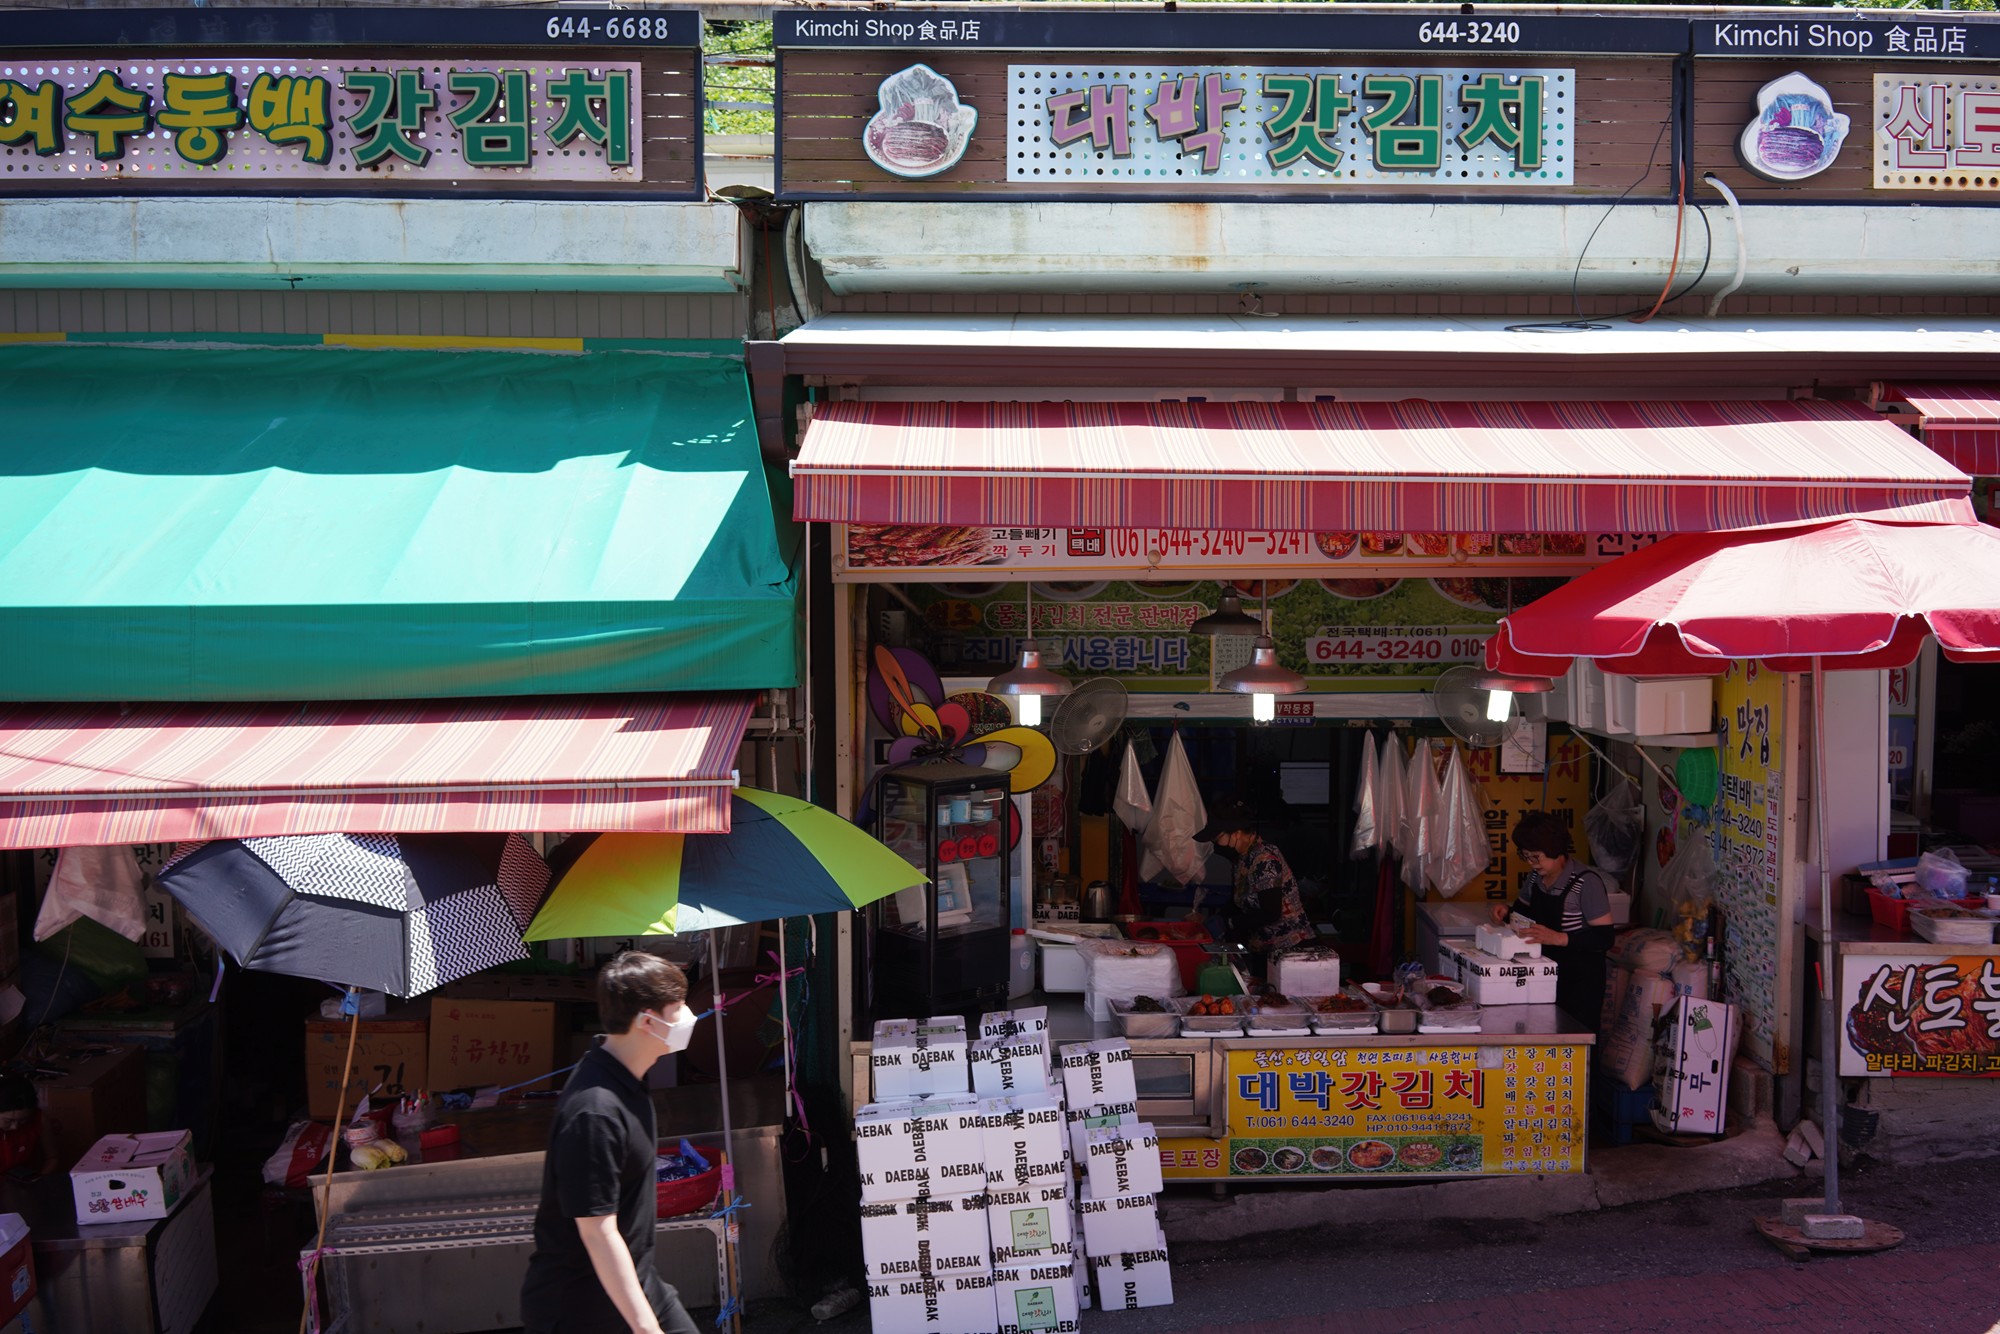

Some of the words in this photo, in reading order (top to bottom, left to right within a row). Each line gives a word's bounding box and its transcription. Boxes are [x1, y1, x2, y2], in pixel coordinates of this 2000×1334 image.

[546, 17, 669, 39] 644-6688
[795, 20, 859, 38] Kimchi
[864, 20, 914, 40] Shop
[917, 20, 980, 41] 食品店
[1418, 22, 1520, 43] 644-3240
[1714, 24, 1799, 46] Kimchi
[1807, 26, 1873, 49] Shop
[1883, 26, 1967, 53] 食品店
[1071, 538, 1101, 553] 택배
[1091, 604, 1134, 625] 전문
[1138, 604, 1201, 626] 판매점
[1063, 636, 1189, 671] 사용합니다
[1315, 640, 1442, 660] 644-3240
[1737, 699, 1769, 766] 맛집
[1291, 1114, 1355, 1127] 644-3240
[941, 1162, 985, 1178] DAEBAK
[936, 1255, 981, 1270] DAEBAK
